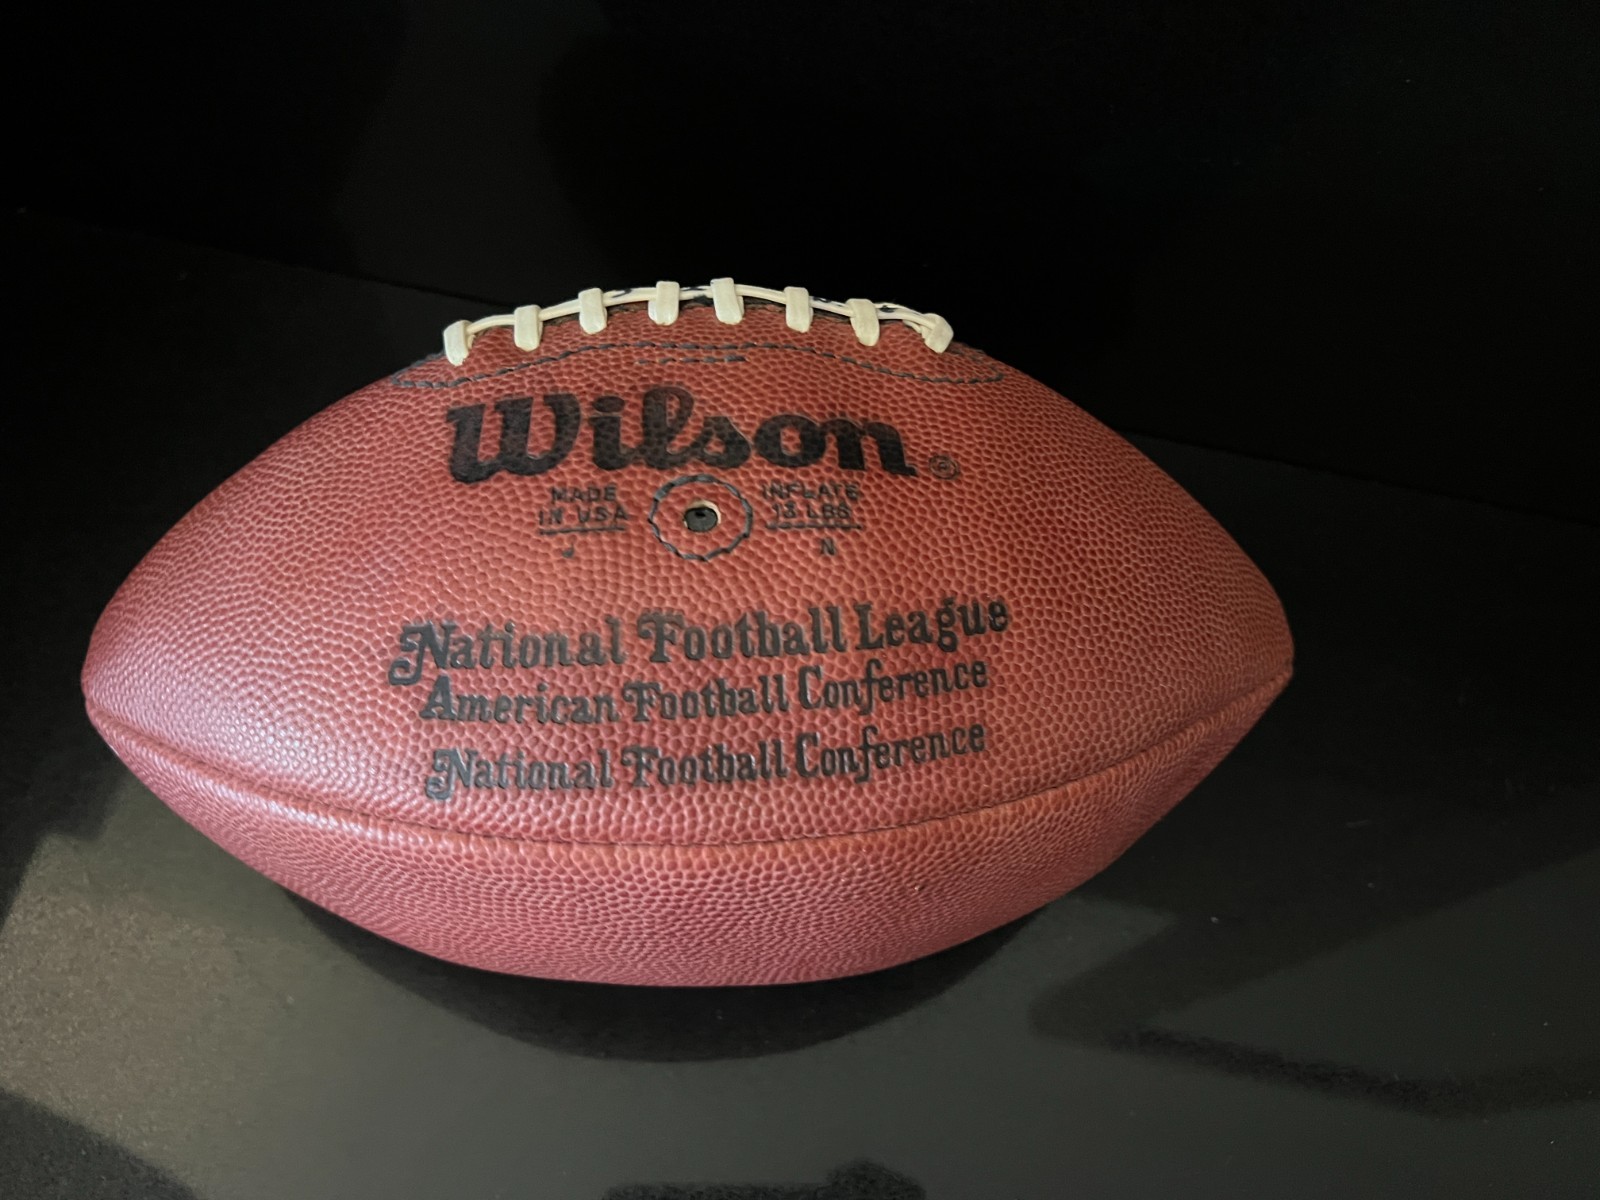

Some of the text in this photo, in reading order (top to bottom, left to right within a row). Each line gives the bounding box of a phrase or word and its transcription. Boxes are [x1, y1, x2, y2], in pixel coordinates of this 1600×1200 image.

[447, 386, 917, 483] Wilson
[551, 484, 618, 502] MADE
[762, 480, 859, 500] INFLATE
[772, 501, 854, 520] 13 LBS
[538, 504, 629, 526] IN USA
[388, 598, 1010, 685] National Football League
[419, 658, 989, 725] American Football Conference
[425, 722, 986, 801] National Football Conference
